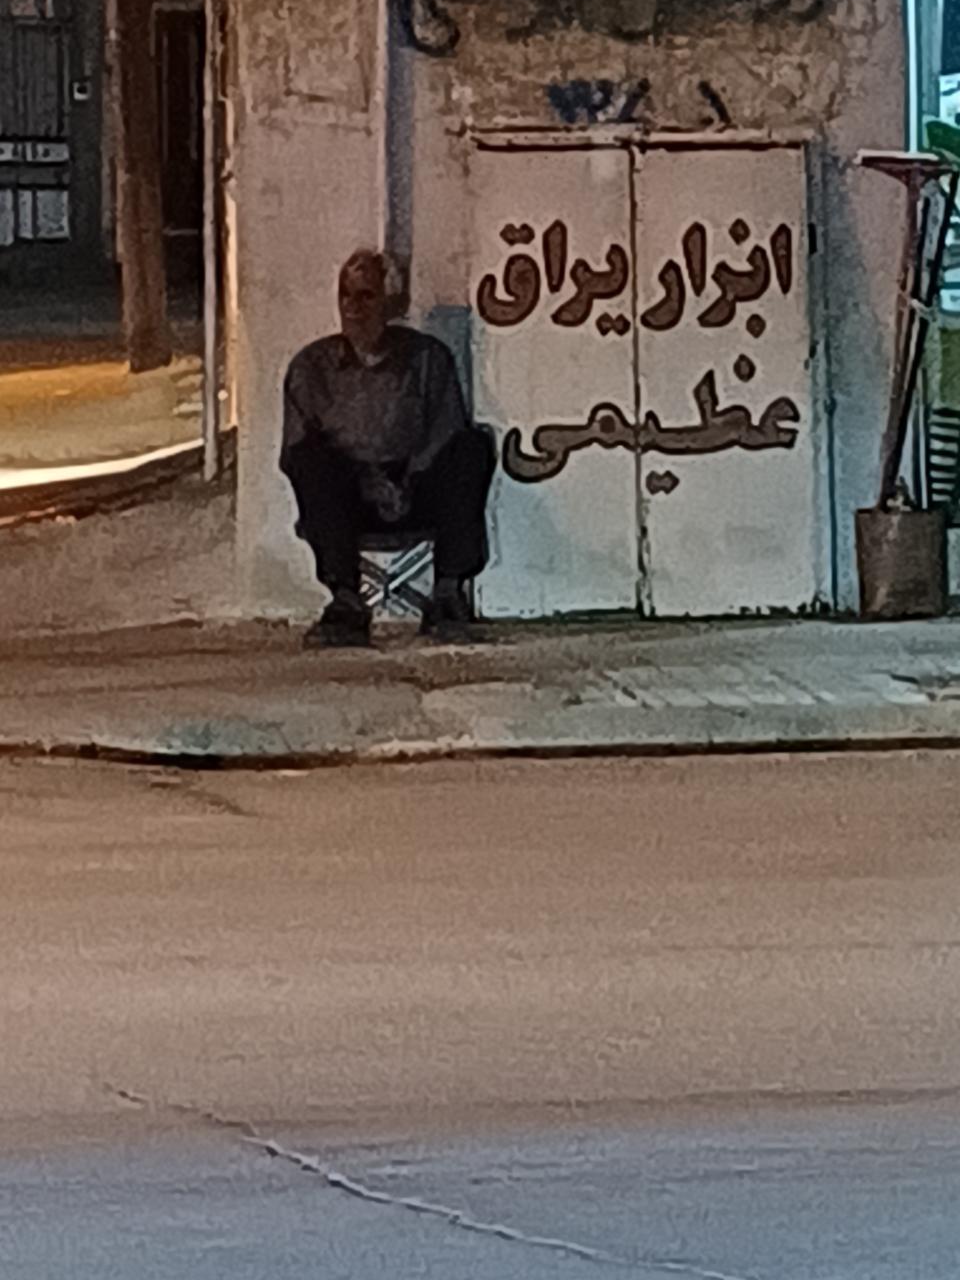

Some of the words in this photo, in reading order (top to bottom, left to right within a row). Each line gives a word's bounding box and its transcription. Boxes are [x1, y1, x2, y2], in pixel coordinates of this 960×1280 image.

[477, 219, 631, 336] یراق
[641, 218, 793, 338] ابزار
[502, 354, 800, 496] عظیمی
